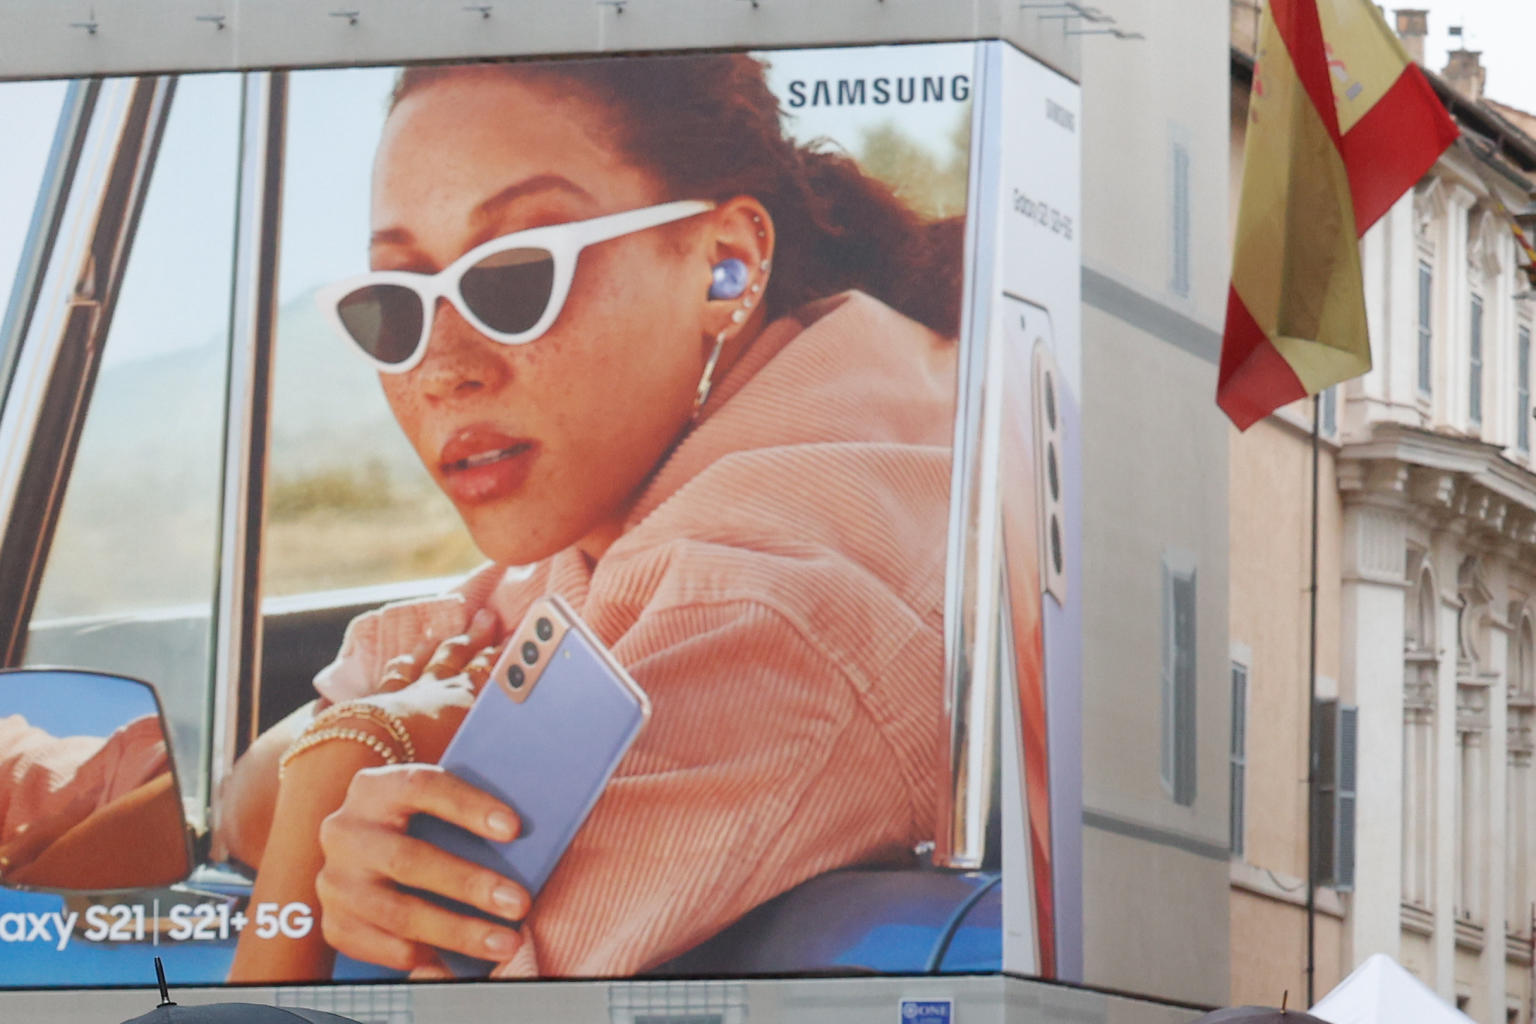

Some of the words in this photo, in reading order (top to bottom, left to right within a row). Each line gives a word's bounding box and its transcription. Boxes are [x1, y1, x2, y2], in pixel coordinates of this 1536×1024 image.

[788, 74, 970, 108] SAMSUNG
[84, 904, 144, 942] S21
[169, 902, 248, 942] S21+
[254, 901, 314, 940] 5G
